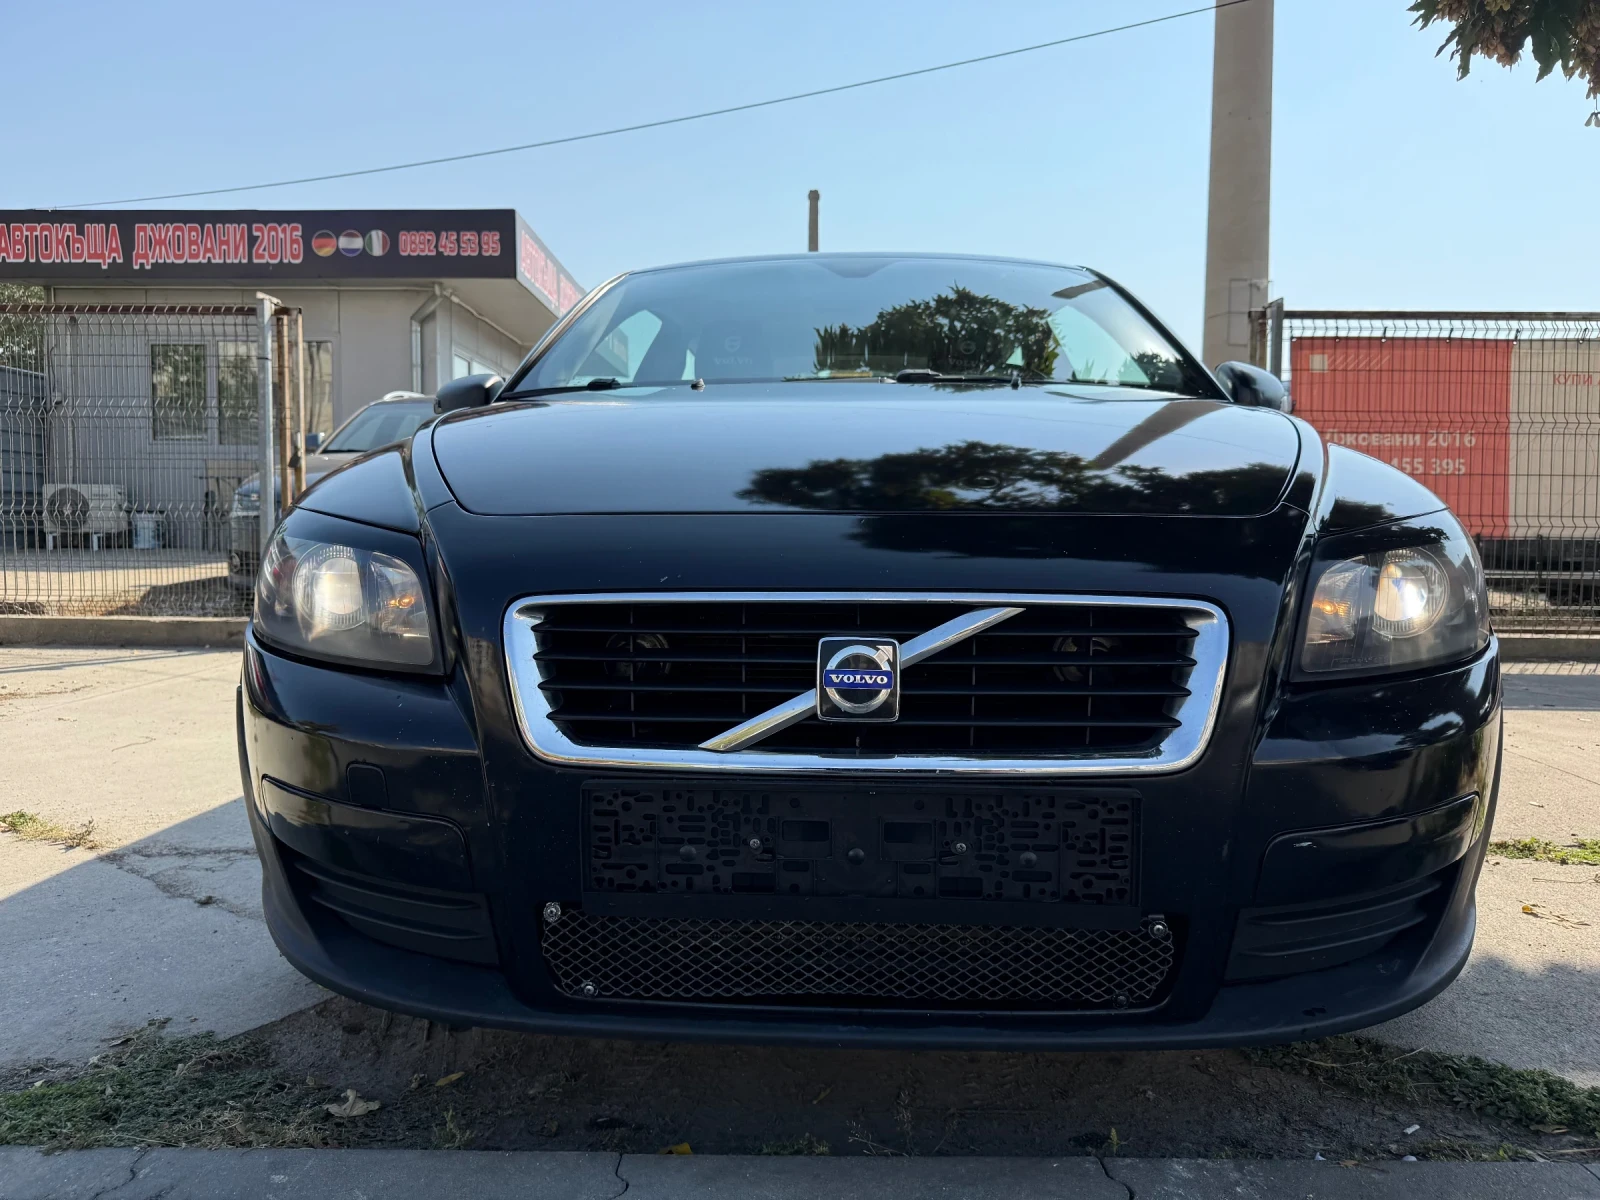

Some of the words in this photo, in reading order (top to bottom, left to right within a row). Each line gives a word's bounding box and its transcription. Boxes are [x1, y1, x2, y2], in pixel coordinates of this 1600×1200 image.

[0, 223, 123, 269] АВТОКЪЩА
[133, 223, 248, 269] ДЖОВАНИ
[252, 223, 303, 264] 2016
[399, 231, 436, 256] 0892
[438, 231, 458, 256] 45
[459, 231, 479, 256] 53
[481, 231, 500, 256] 95
[1553, 373, 1593, 386] КУПИ
[1426, 430, 1476, 448] 2016
[1430, 457, 1466, 475] 395
[829, 674, 888, 684] VOLVO
